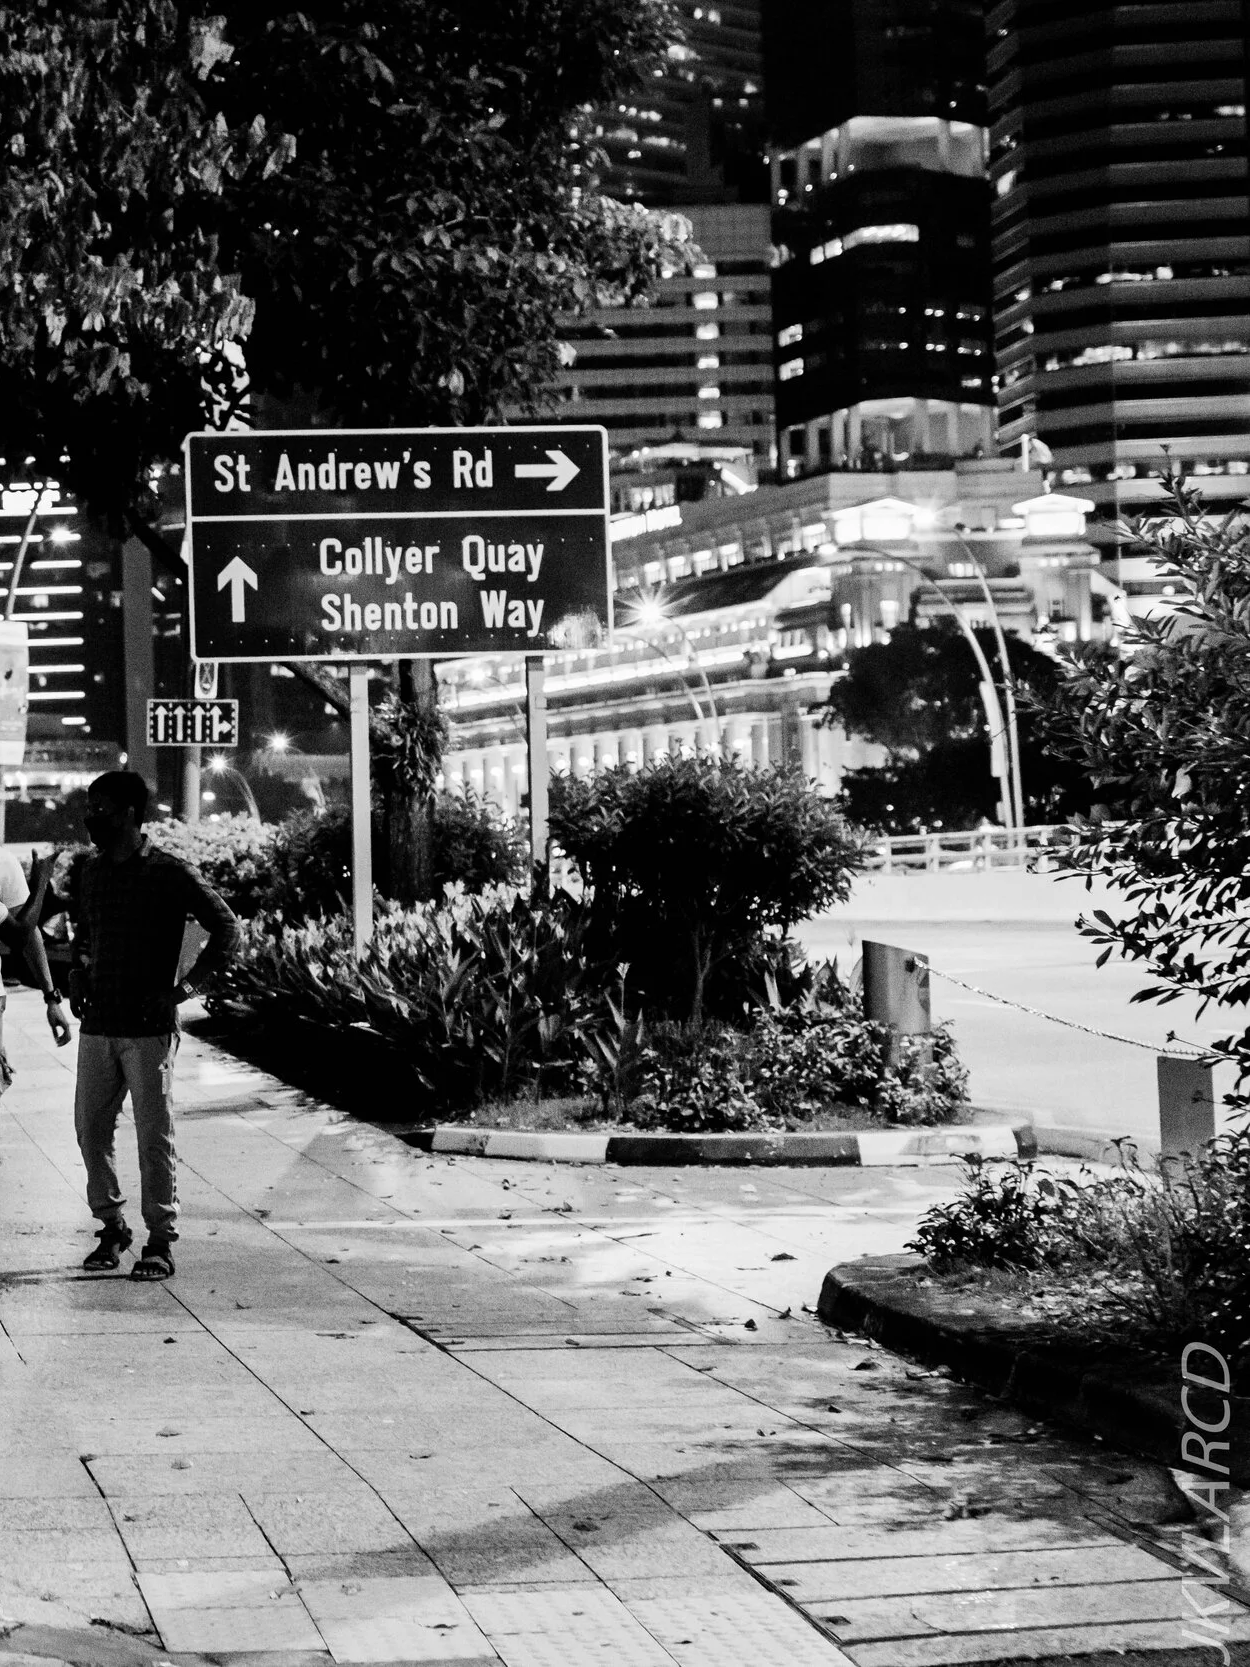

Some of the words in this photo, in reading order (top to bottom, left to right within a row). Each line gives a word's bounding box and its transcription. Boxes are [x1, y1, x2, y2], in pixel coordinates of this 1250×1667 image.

[213, 454, 252, 493] St
[274, 450, 432, 493] Andrew's
[453, 446, 494, 489] Rd
[319, 536, 441, 586] Collyer
[462, 534, 545, 583] Quay
[320, 592, 459, 632] Shenton
[480, 589, 545, 638] Way
